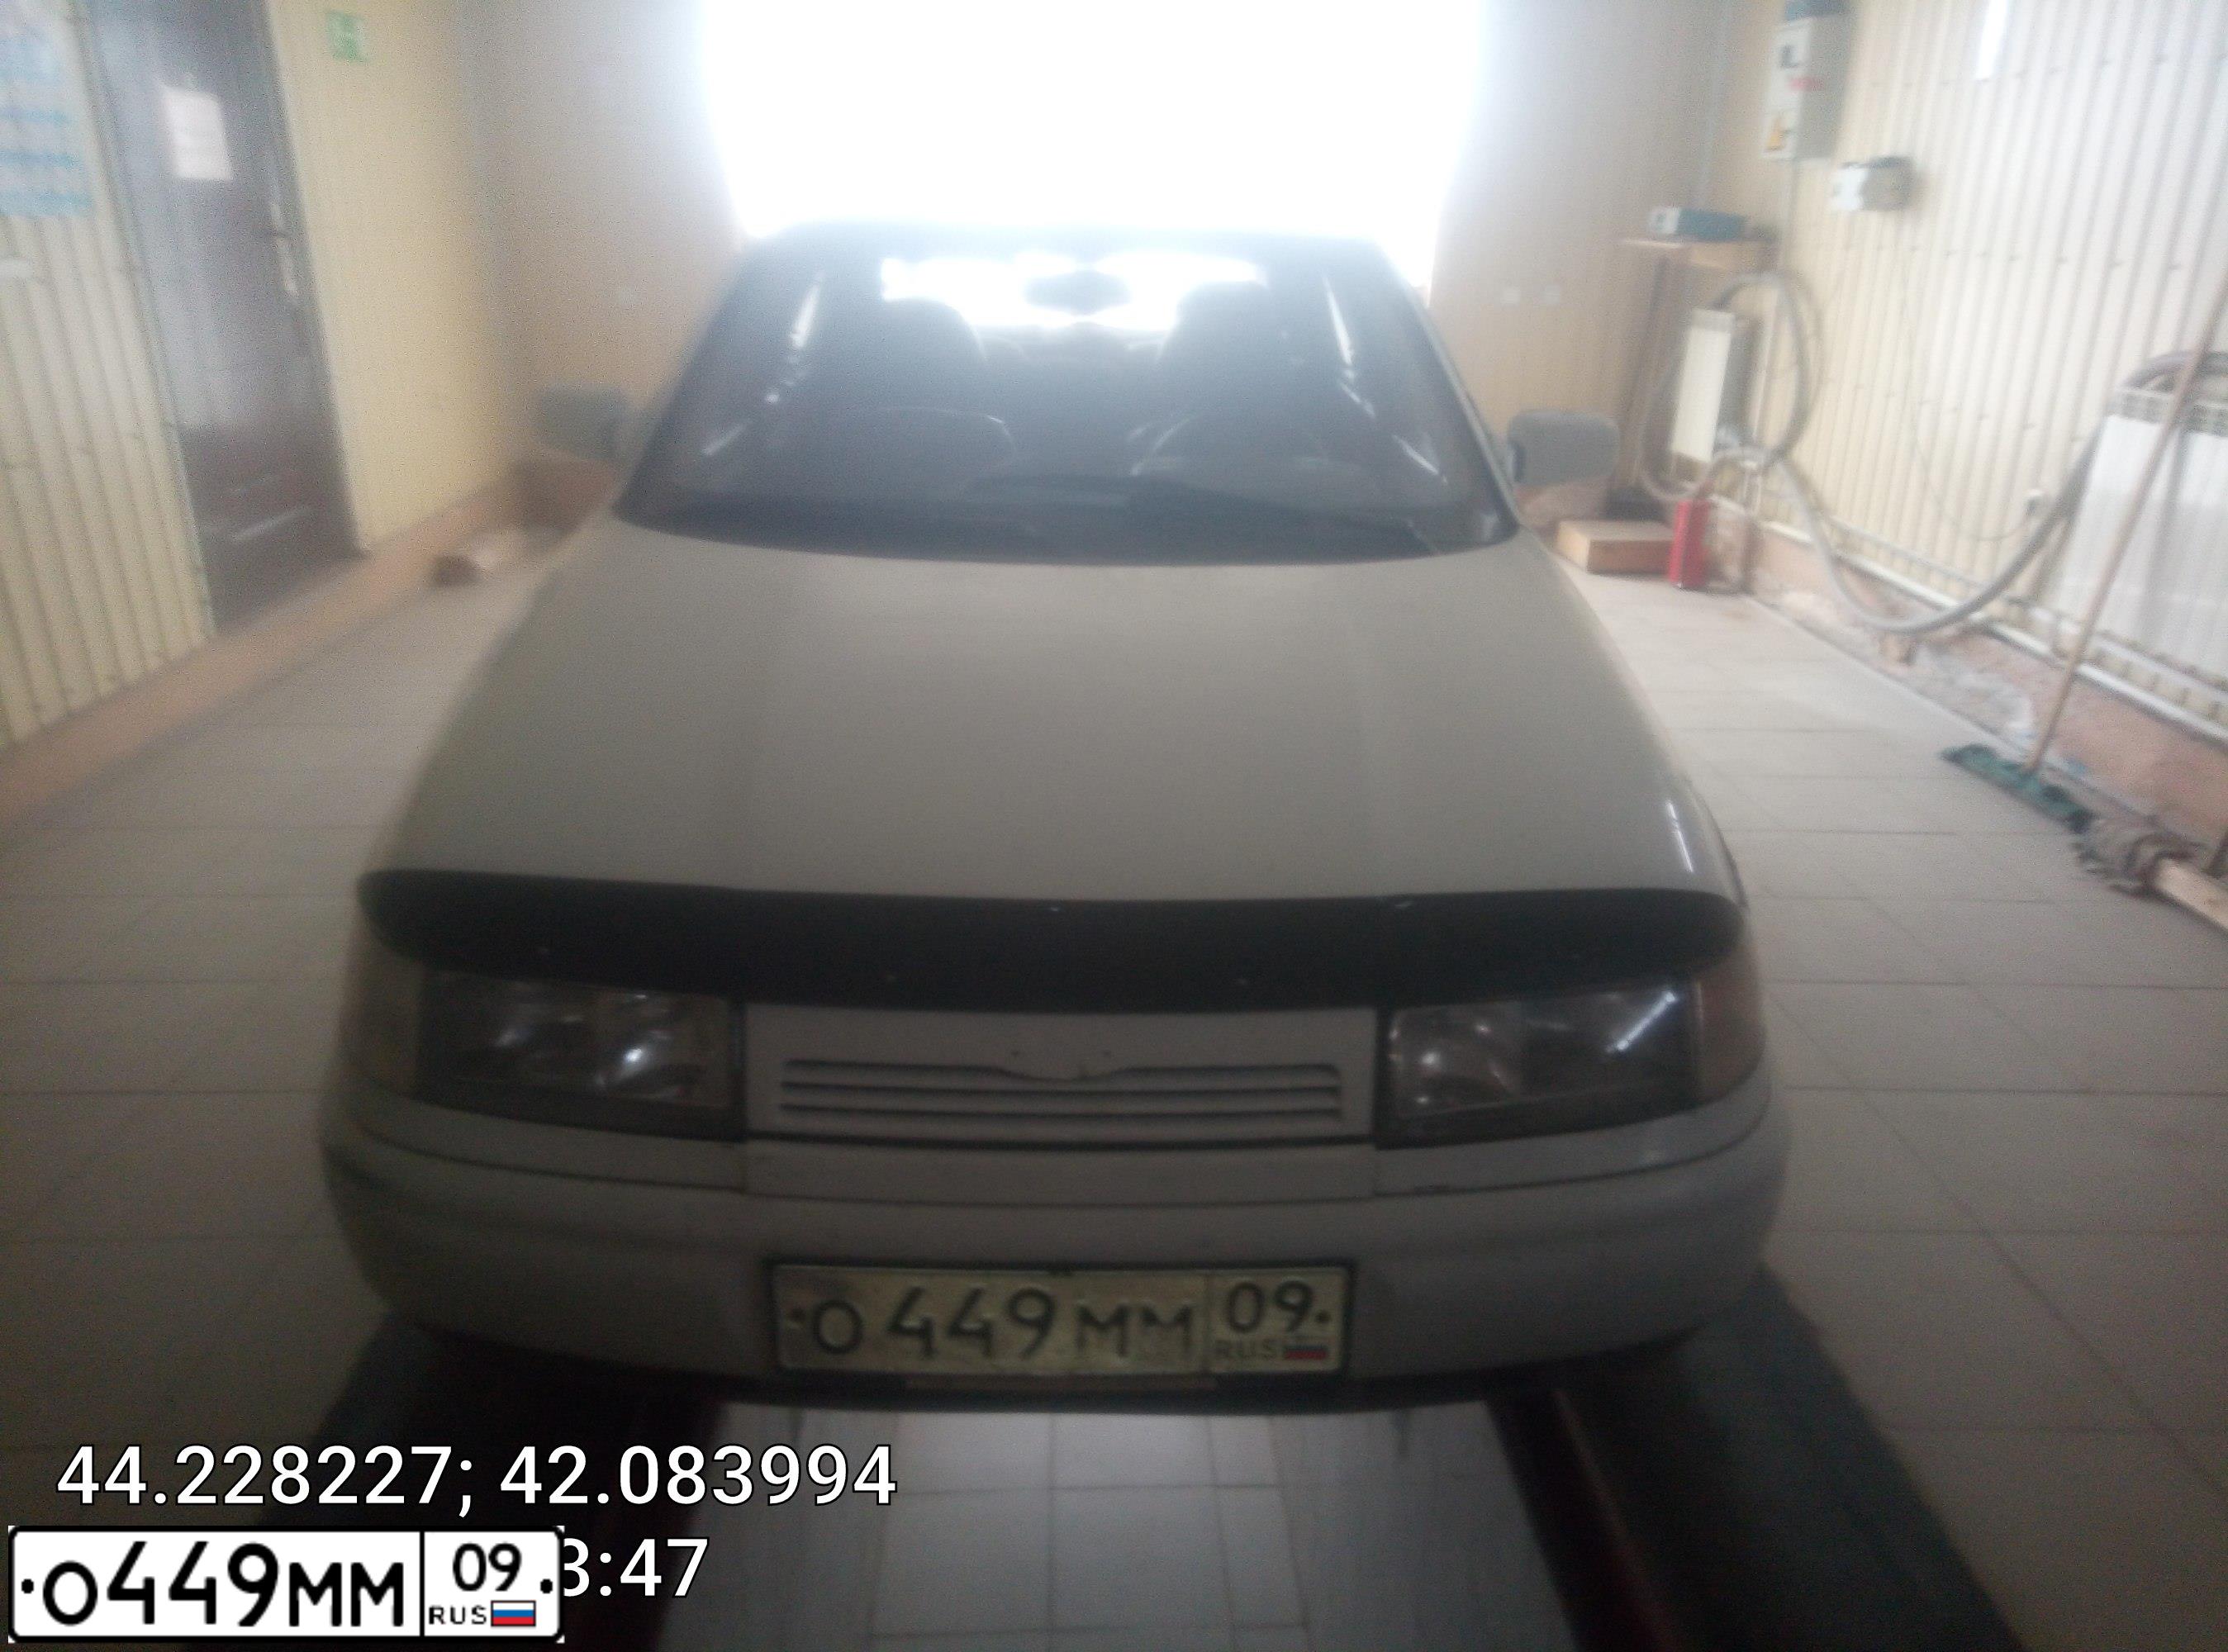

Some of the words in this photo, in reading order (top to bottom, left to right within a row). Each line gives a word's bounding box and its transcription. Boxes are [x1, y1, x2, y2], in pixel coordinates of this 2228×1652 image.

[885, 1286, 1058, 1360] 449
[1227, 1279, 1315, 1334] 09
[1214, 1338, 1278, 1360] RUS
